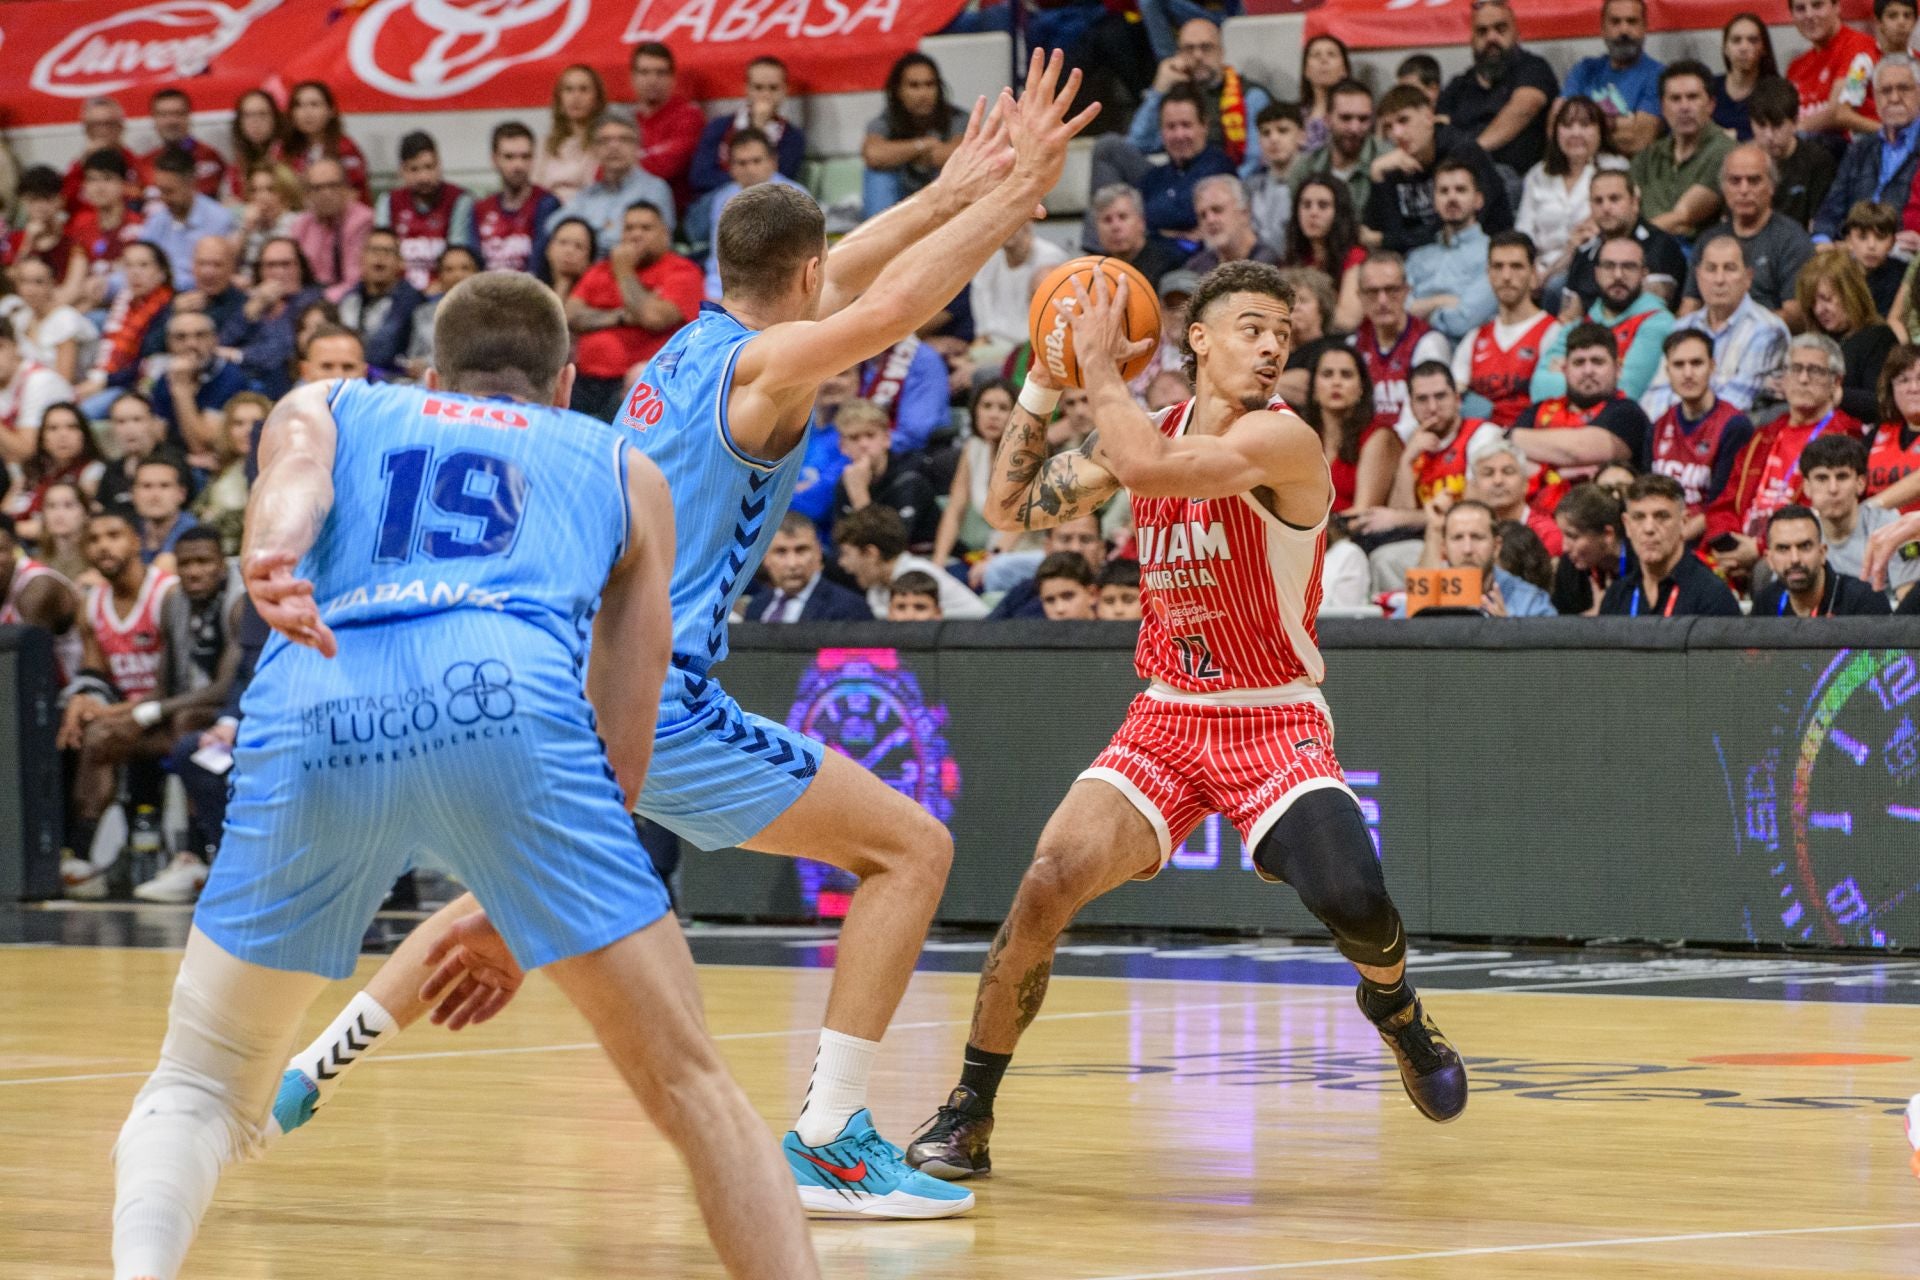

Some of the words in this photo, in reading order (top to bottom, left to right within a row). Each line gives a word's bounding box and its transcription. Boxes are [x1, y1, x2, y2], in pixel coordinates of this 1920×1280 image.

[372, 444, 533, 563] 19
[1144, 568, 1217, 591] MURCIA
[1171, 634, 1221, 679] 12
[331, 700, 439, 746] LUGO
[303, 726, 522, 771] VICEPRESIDENCIA
